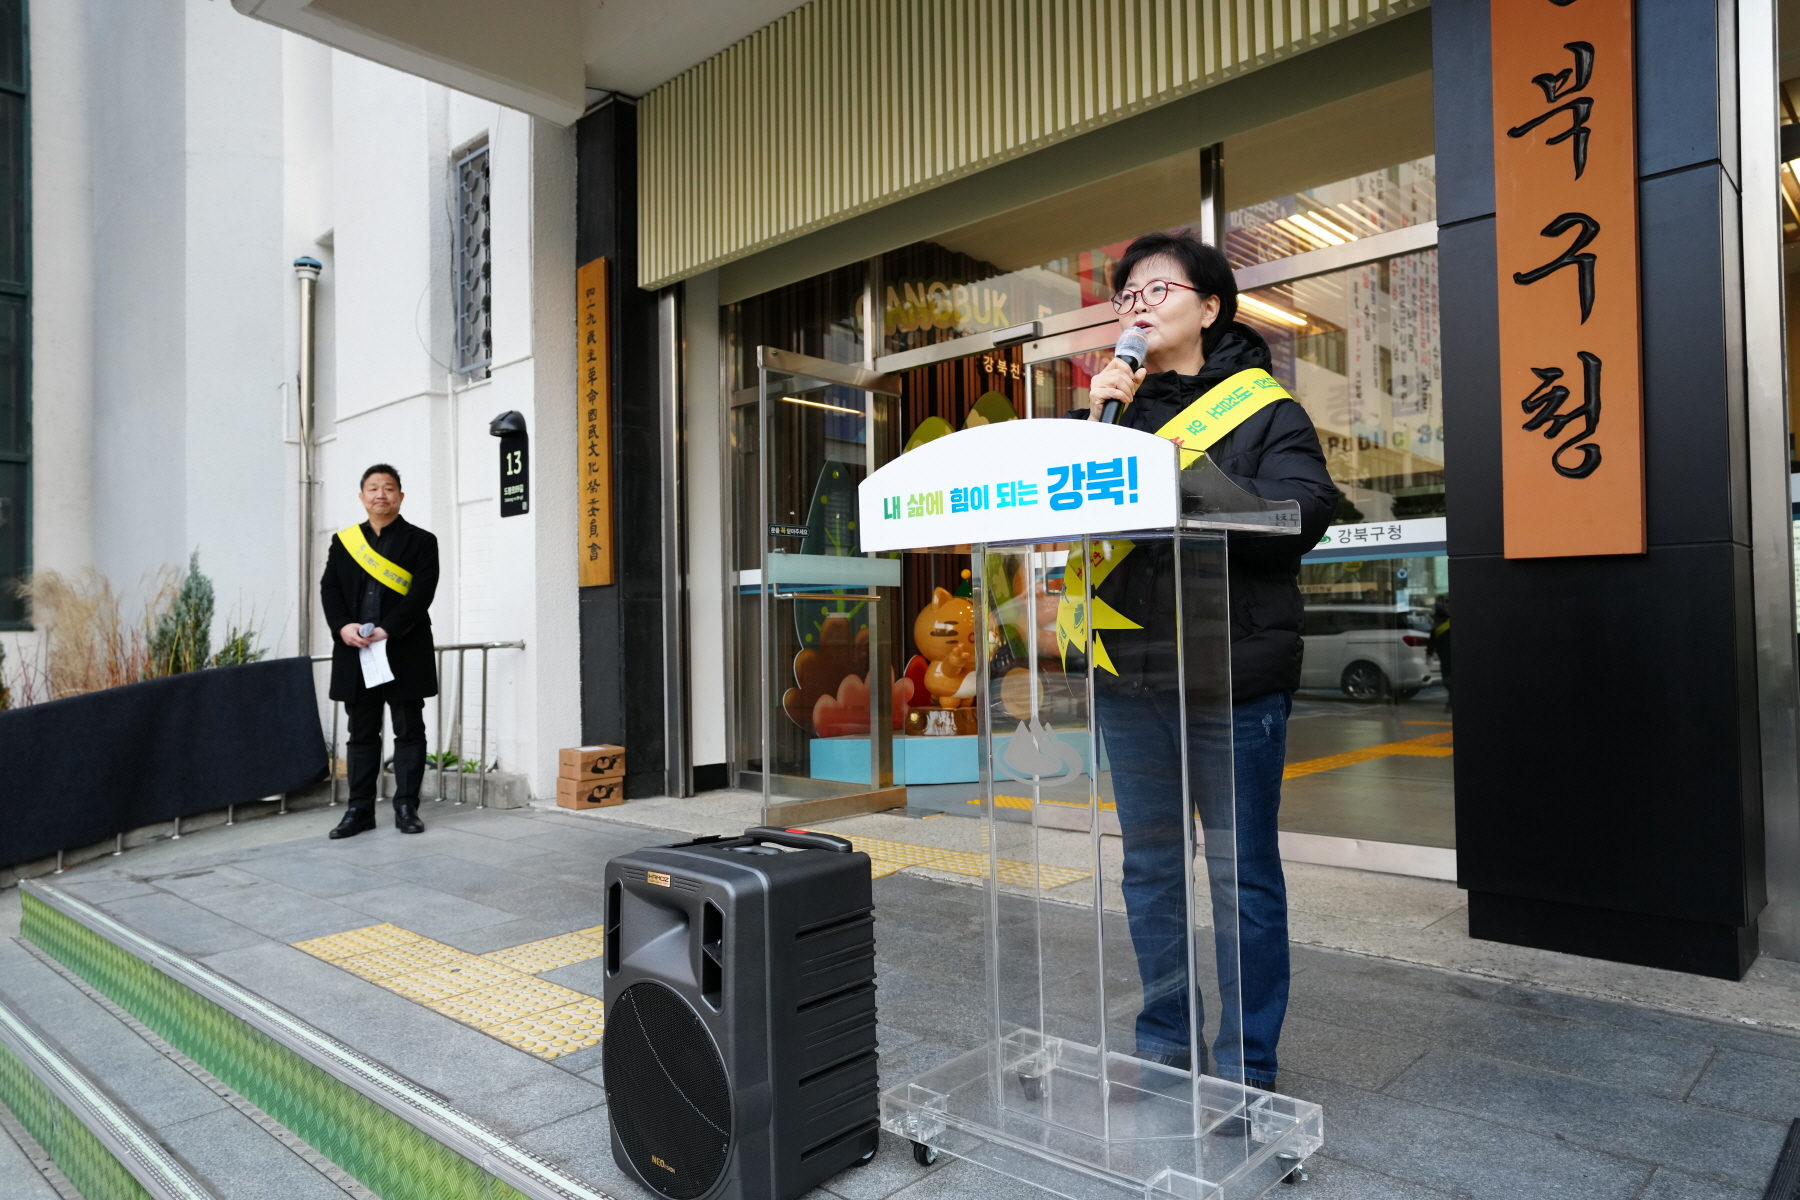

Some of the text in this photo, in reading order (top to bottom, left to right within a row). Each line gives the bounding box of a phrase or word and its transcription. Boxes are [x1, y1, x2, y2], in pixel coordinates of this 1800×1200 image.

[1507, 0, 1603, 479] 북구청
[983, 356, 1045, 386] 강북친들
[1185, 419, 1208, 436] 앞
[506, 450, 522, 475] 13
[883, 455, 1138, 520] 내 삶에 힘이 되는 강북!
[1337, 524, 1403, 544] 강북구청
